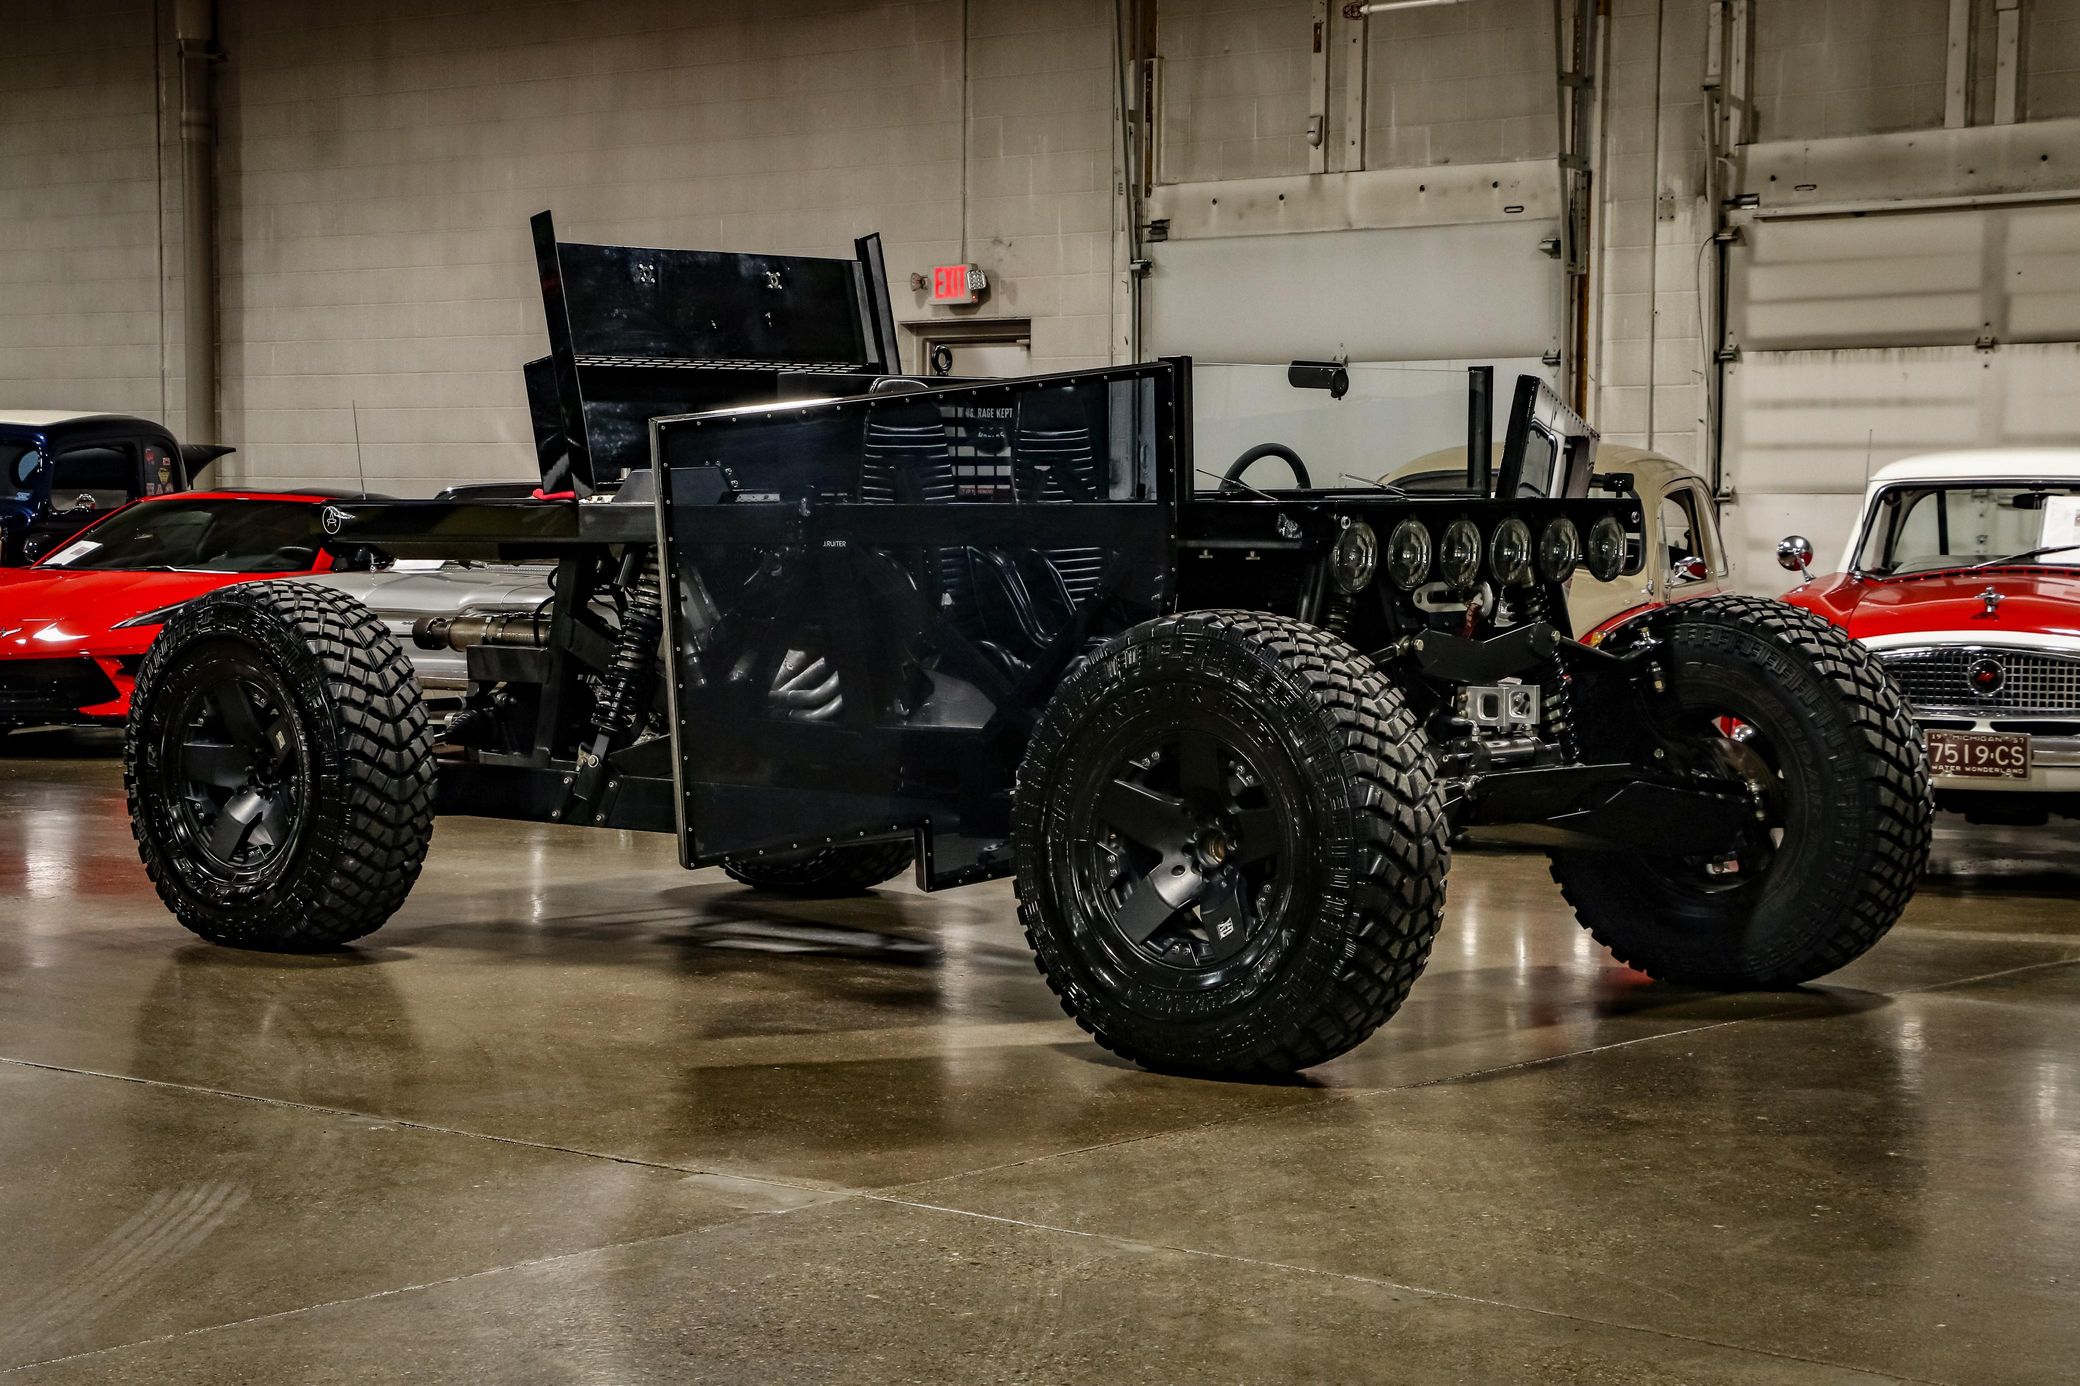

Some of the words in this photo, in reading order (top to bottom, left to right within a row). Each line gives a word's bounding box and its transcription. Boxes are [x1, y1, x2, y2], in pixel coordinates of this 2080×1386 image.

[934, 266, 967, 299] EXIT
[996, 408, 1013, 418] KEPT
[1965, 766, 2024, 774] WONDERLAND
